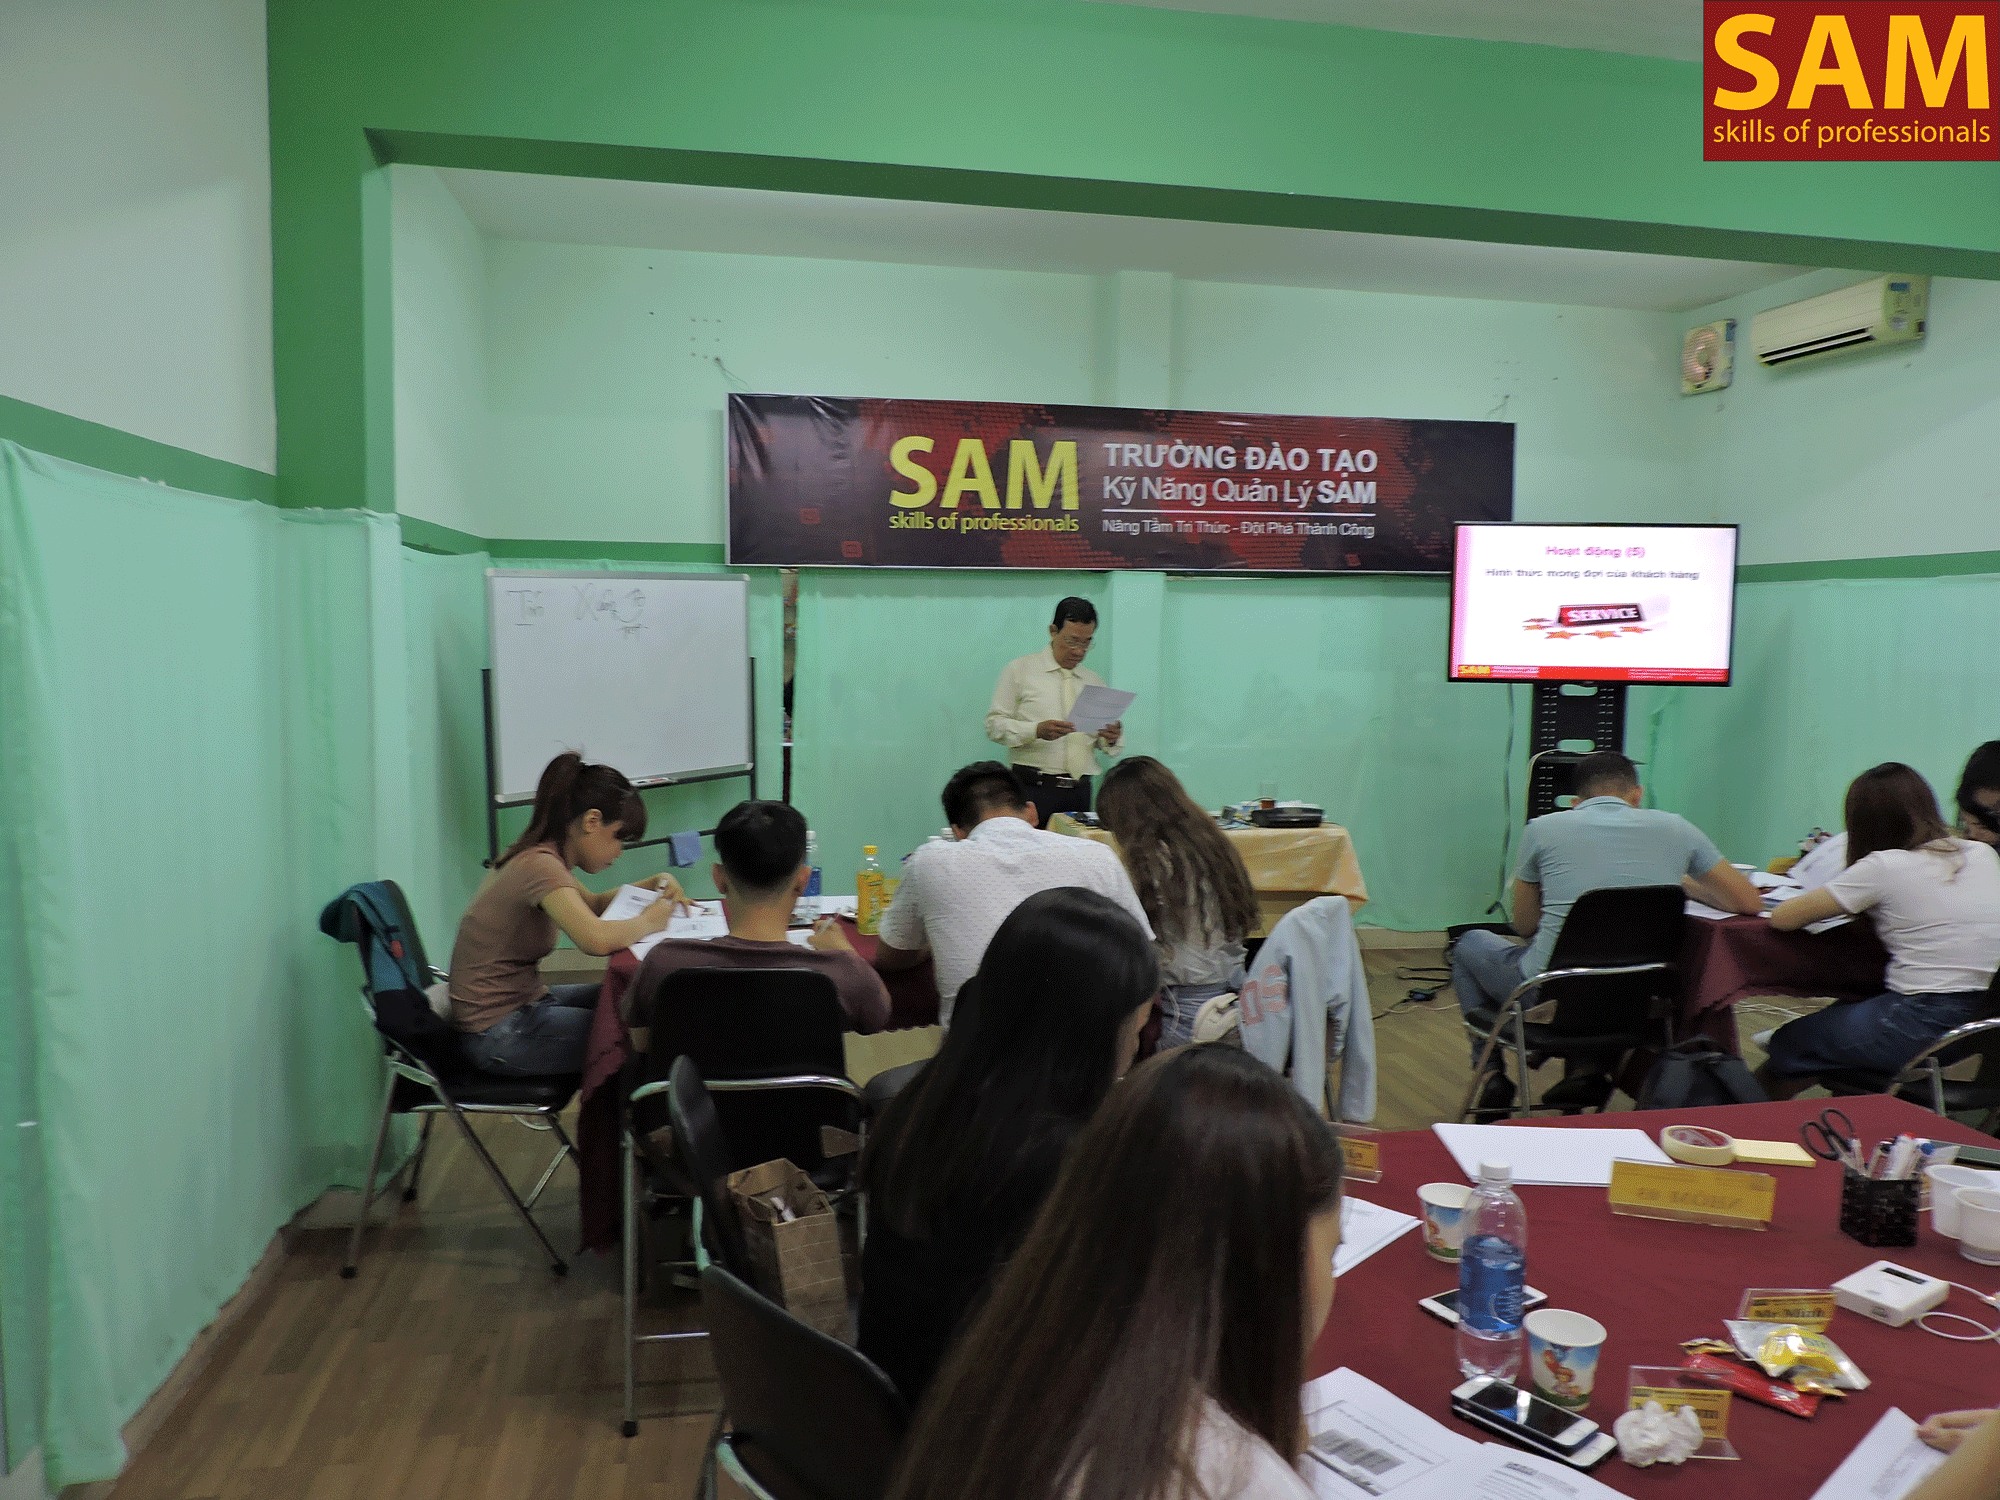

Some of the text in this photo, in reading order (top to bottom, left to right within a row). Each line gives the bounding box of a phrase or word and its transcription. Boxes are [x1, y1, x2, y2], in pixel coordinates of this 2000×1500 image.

[1102, 439, 1378, 477] TRƯỜNG ĐÀO TẠO
[889, 436, 1080, 510] SAM
[1103, 476, 1377, 508] Kỹ Năng Quản Lý SAM
[889, 511, 1080, 534] skills of professionals
[1102, 519, 1140, 536] Nâng
[1240, 521, 1265, 537] Đột
[1567, 607, 1639, 622] SERVICE
